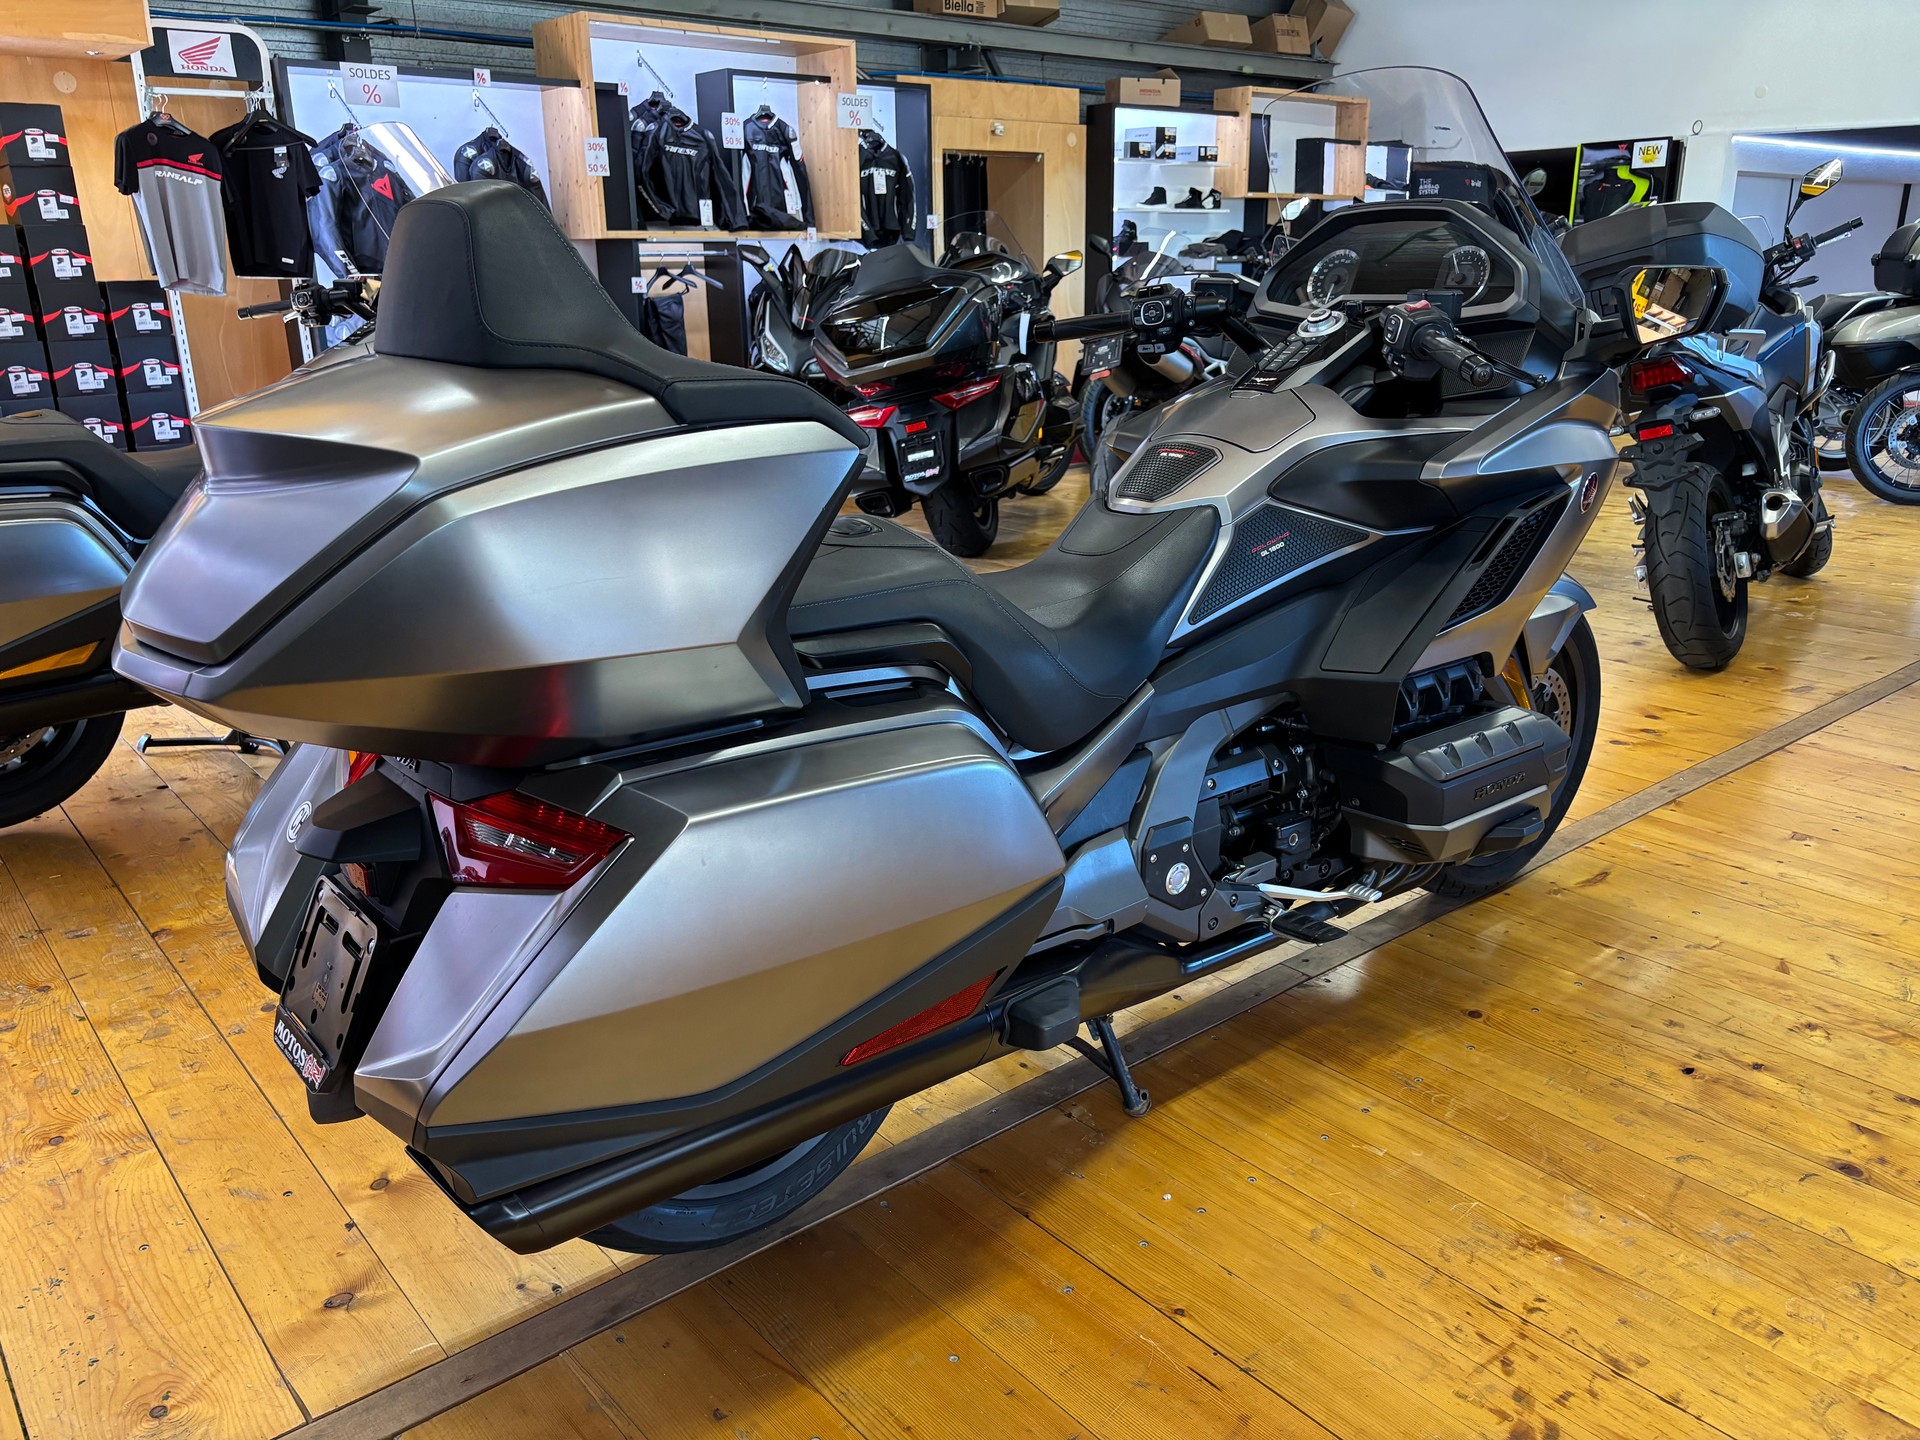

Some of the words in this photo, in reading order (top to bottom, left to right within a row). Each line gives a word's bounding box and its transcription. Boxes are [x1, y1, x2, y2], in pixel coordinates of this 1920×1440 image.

[944, 0, 974, 13] Biella
[181, 64, 228, 73] HONDA
[349, 67, 391, 80] SOLDES
[476, 72, 486, 84] %
[362, 84, 382, 104] %
[841, 97, 868, 107] SOLDES
[724, 117, 740, 126] 30%
[849, 110, 862, 126] %
[587, 142, 605, 151] 30%
[725, 137, 734, 145] 50
[1638, 145, 1663, 156] NEW
[588, 164, 599, 173] 50
[600, 164, 608, 173] %
[155, 170, 203, 185] RANSALP
[1474, 772, 1526, 800] HONDA
[275, 1019, 307, 1067] MOTOS
[734, 1112, 876, 1226] RUISETEC
